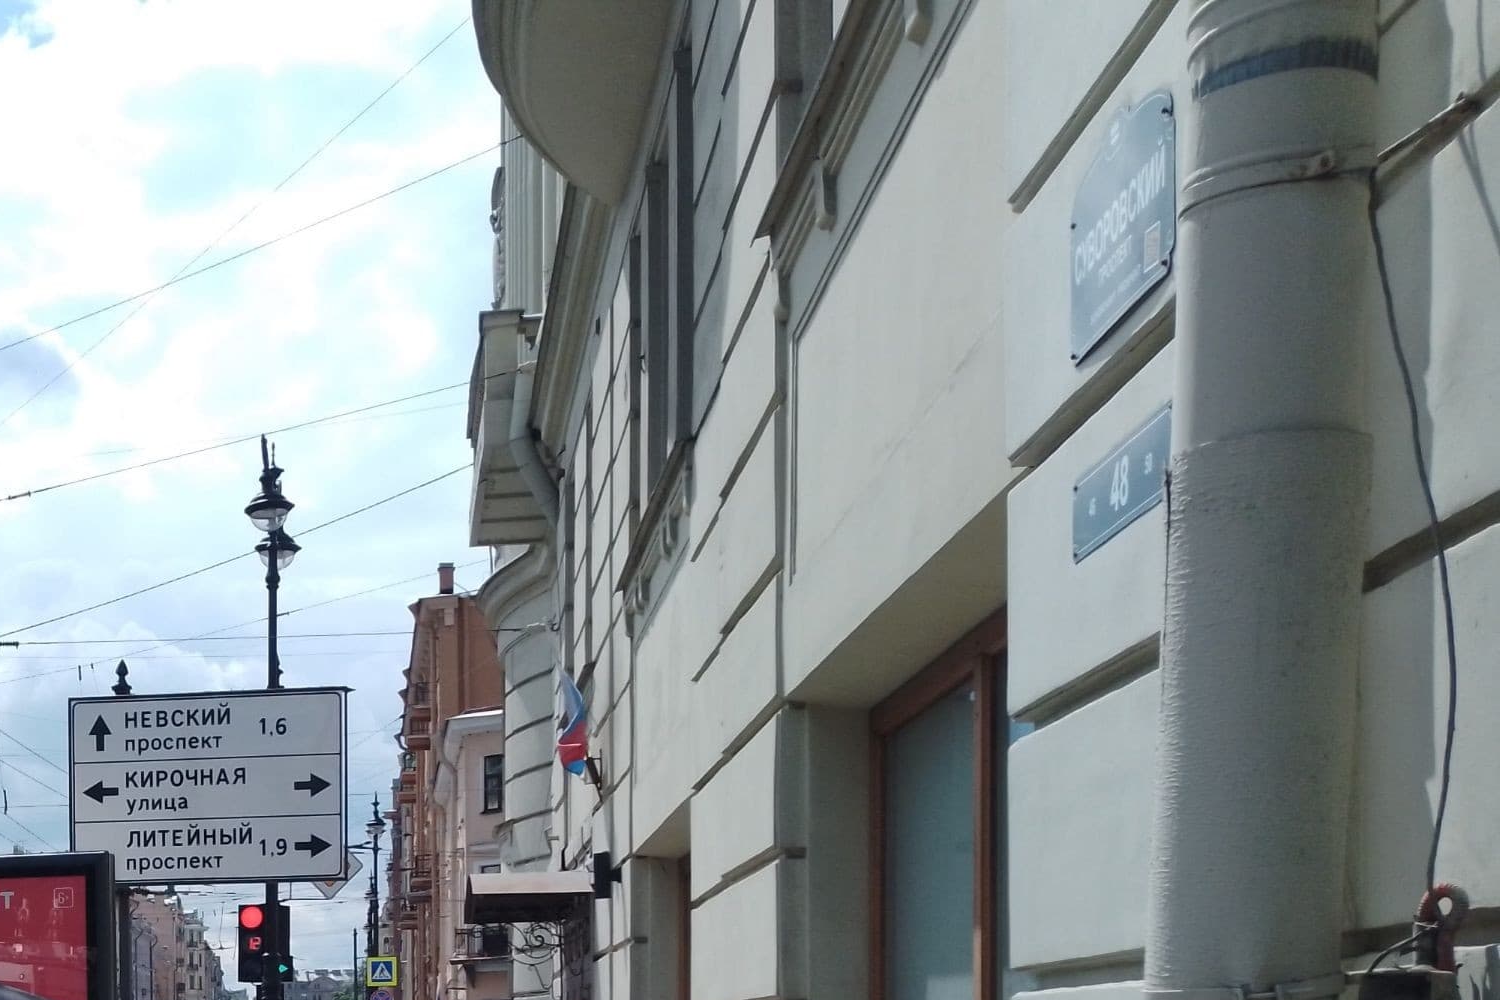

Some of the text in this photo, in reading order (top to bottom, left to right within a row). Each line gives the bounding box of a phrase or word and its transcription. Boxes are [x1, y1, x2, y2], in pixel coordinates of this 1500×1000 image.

[1075, 136, 1166, 286] СУВОРОВСКИЙ
[1110, 454, 1130, 512] 48
[124, 702, 231, 729] НЕВСКИЙ
[124, 735, 223, 756] проспект
[125, 767, 247, 789] КИРОЧНАЯ
[126, 795, 189, 815] улица
[126, 822, 253, 849] ЛИТЕЙНЫЙ
[126, 854, 224, 875] проспект
